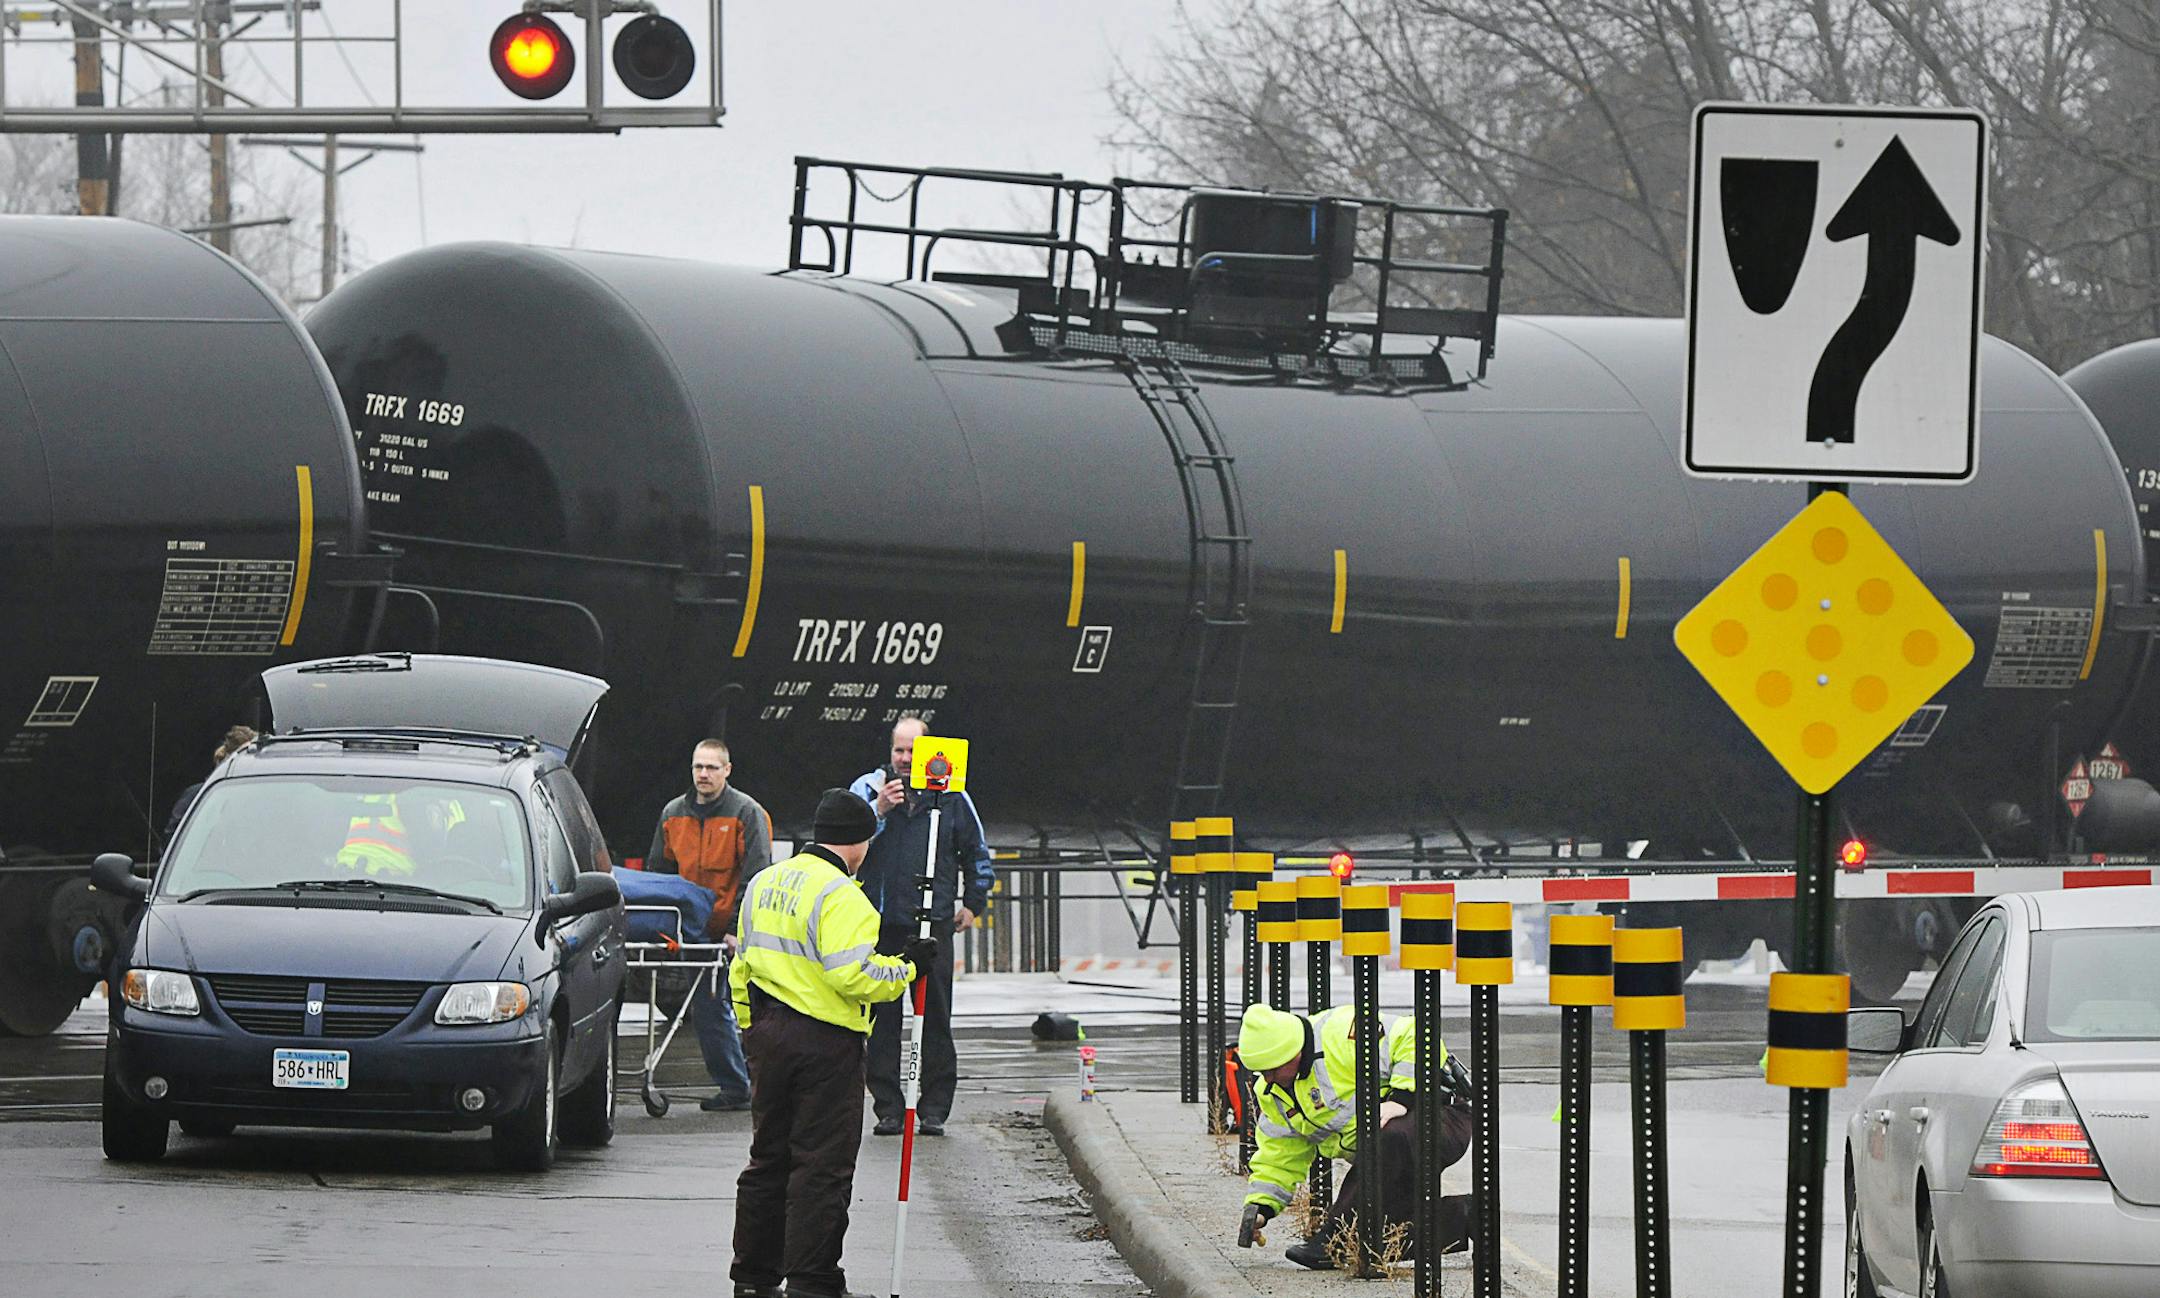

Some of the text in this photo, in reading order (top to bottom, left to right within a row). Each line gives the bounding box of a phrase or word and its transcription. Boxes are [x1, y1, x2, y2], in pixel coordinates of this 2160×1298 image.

[365, 393, 465, 425] TRFX 1669
[402, 436, 415, 447] GAL
[391, 464, 414, 475] OUTER
[367, 490, 401, 503] AKE BEAM
[792, 619, 943, 665] TRFX 1669
[1086, 648, 1097, 664] C
[773, 681, 790, 696] LD
[788, 681, 812, 696] LMT
[864, 683, 879, 698] LB
[931, 684, 948, 699] KG
[760, 706, 776, 720] LT
[851, 708, 867, 722] LB
[278, 1060, 344, 1080] 586 HRL
